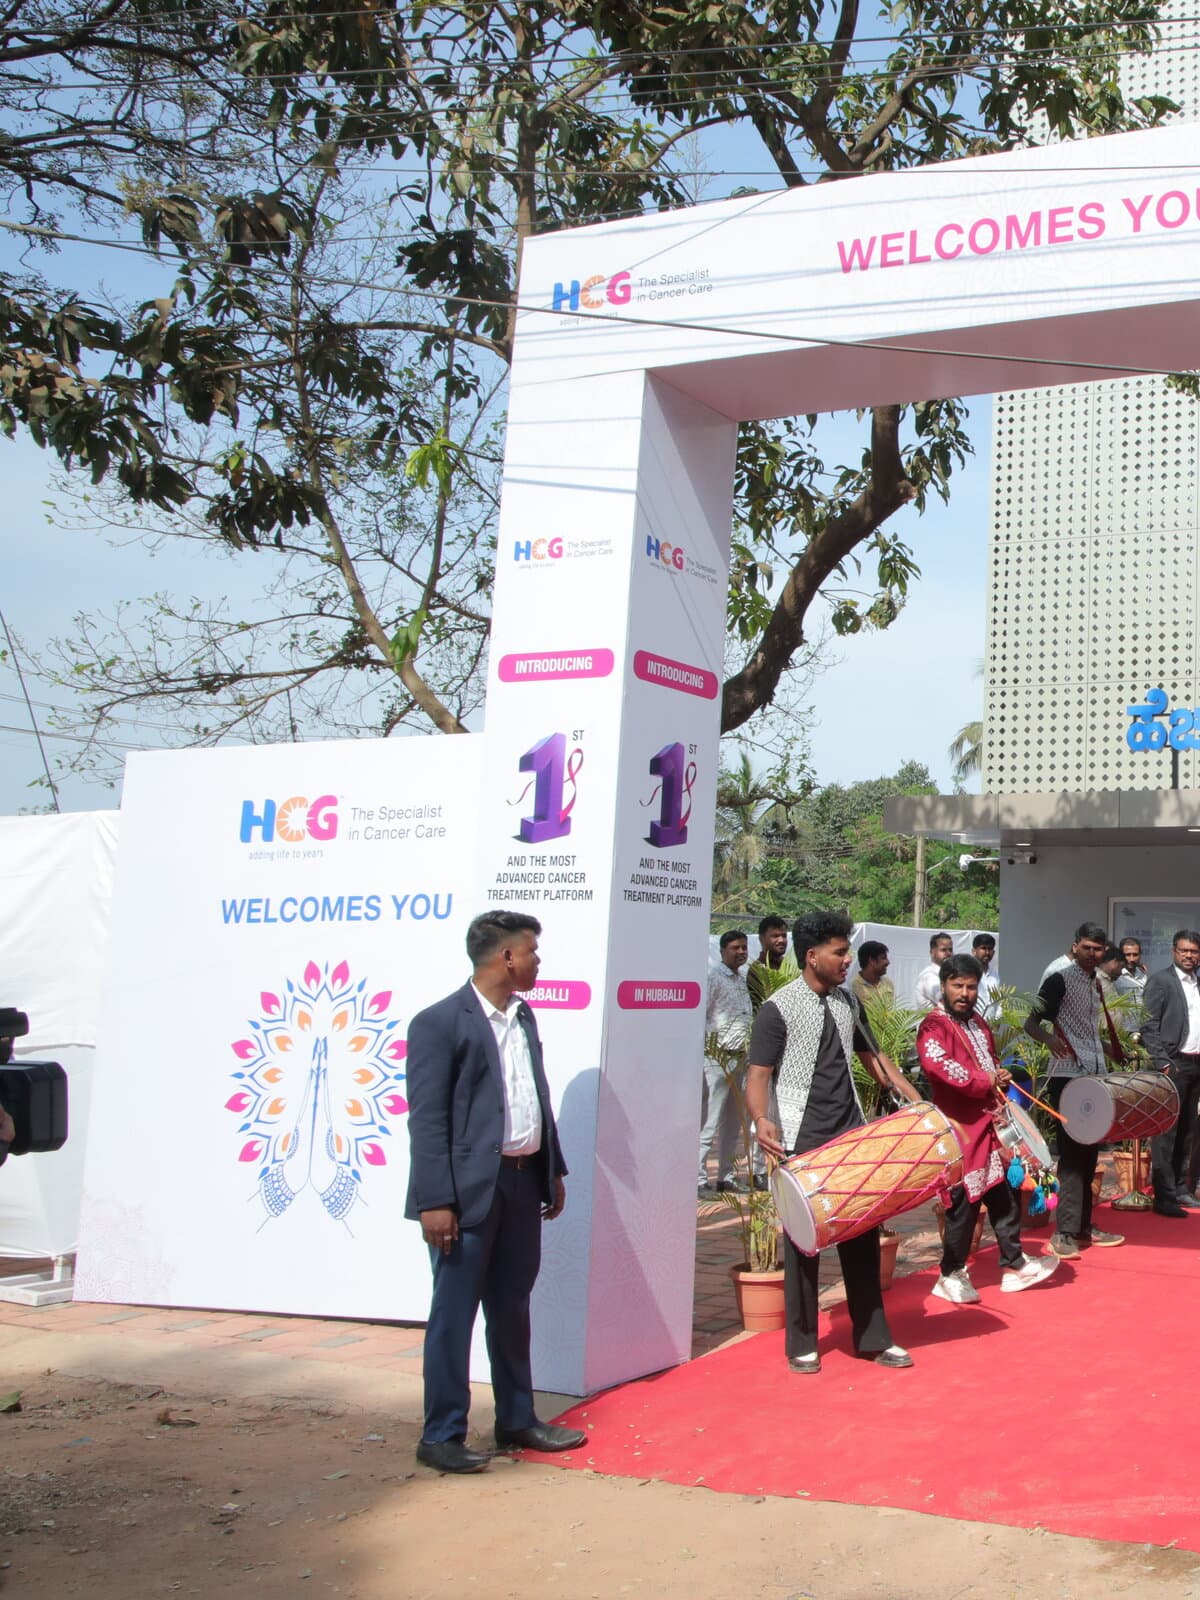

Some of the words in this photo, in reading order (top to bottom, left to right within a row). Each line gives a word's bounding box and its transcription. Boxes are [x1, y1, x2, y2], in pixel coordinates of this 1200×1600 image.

[838, 202, 1106, 274] WELCOMES
[639, 277, 657, 287] The
[660, 269, 710, 285] Specialist
[552, 272, 631, 311] HCG
[637, 293, 646, 303] in
[649, 288, 685, 300] Cancer
[688, 283, 712, 295] Care
[514, 537, 563, 561] HCG
[646, 535, 684, 570] HCG
[515, 656, 592, 674] INTRODUCING
[647, 660, 704, 689] INTRODUCING
[240, 795, 338, 843] HCG
[351, 807, 374, 820] The
[379, 805, 442, 822] Specialist
[348, 827, 359, 840] in
[364, 826, 410, 840] Cancer
[415, 824, 446, 839] Care
[249, 849, 275, 861] adding
[277, 849, 290, 859] life
[292, 850, 300, 858] to
[303, 849, 324, 860] years
[507, 855, 528, 866] AND
[530, 855, 546, 866] THE
[549, 855, 576, 866] MOST
[640, 858, 654, 869] AND
[657, 859, 669, 871] THE
[672, 861, 690, 873] MOST
[496, 872, 545, 883] ADVANCED
[548, 872, 586, 883] CANCER
[631, 875, 668, 888] ADVANCED
[670, 878, 697, 891] CANCER
[488, 889, 540, 901] TREATMENT
[544, 889, 593, 901] PLATFORM
[624, 890, 665, 904] TREATMENT
[667, 894, 702, 907] PLATFORM
[222, 894, 381, 924] WELCOMES
[391, 894, 452, 920] YOU
[635, 989, 643, 1001] IN
[646, 989, 686, 1002] HUBBALLI
